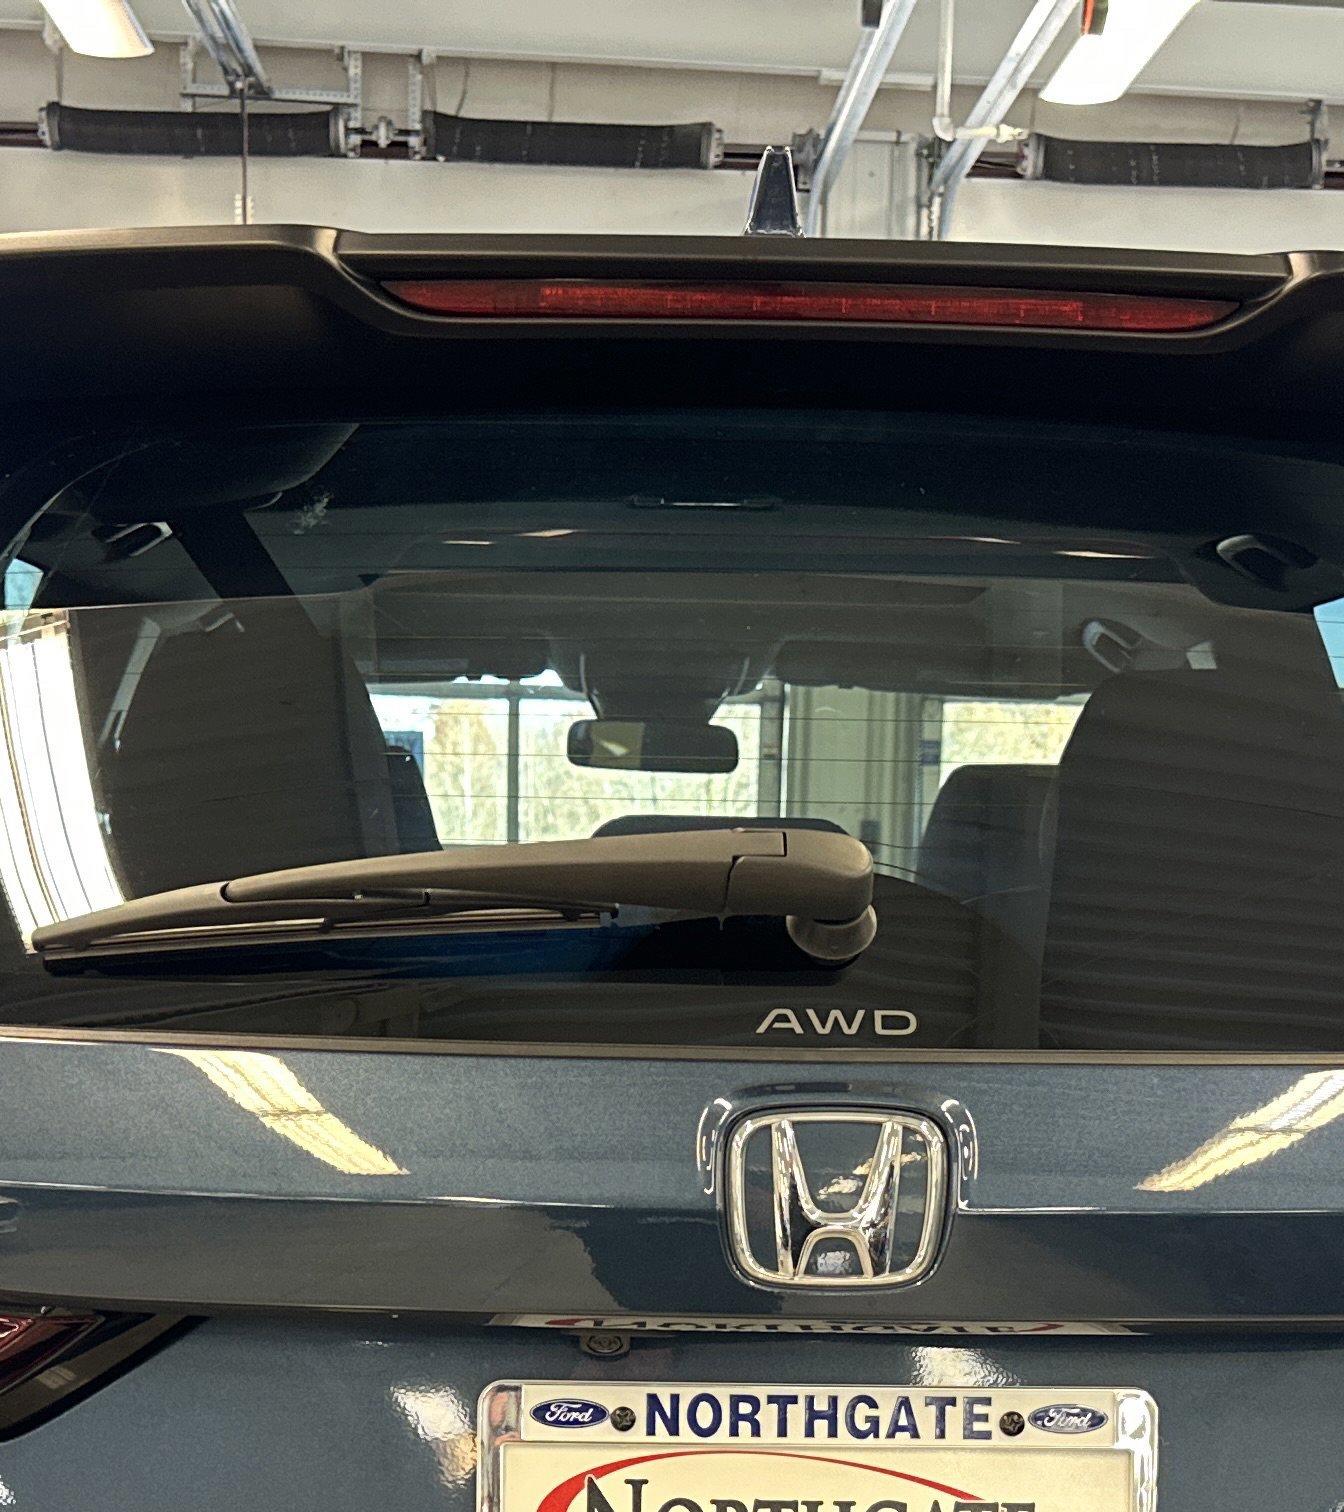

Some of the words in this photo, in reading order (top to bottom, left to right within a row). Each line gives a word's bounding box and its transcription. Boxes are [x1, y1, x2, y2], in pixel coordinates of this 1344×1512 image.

[755, 1008, 918, 1036] AWD
[544, 1402, 593, 1422] Ford
[645, 1393, 993, 1440] NORTHGATE
[1042, 1408, 1092, 1428] Ford
